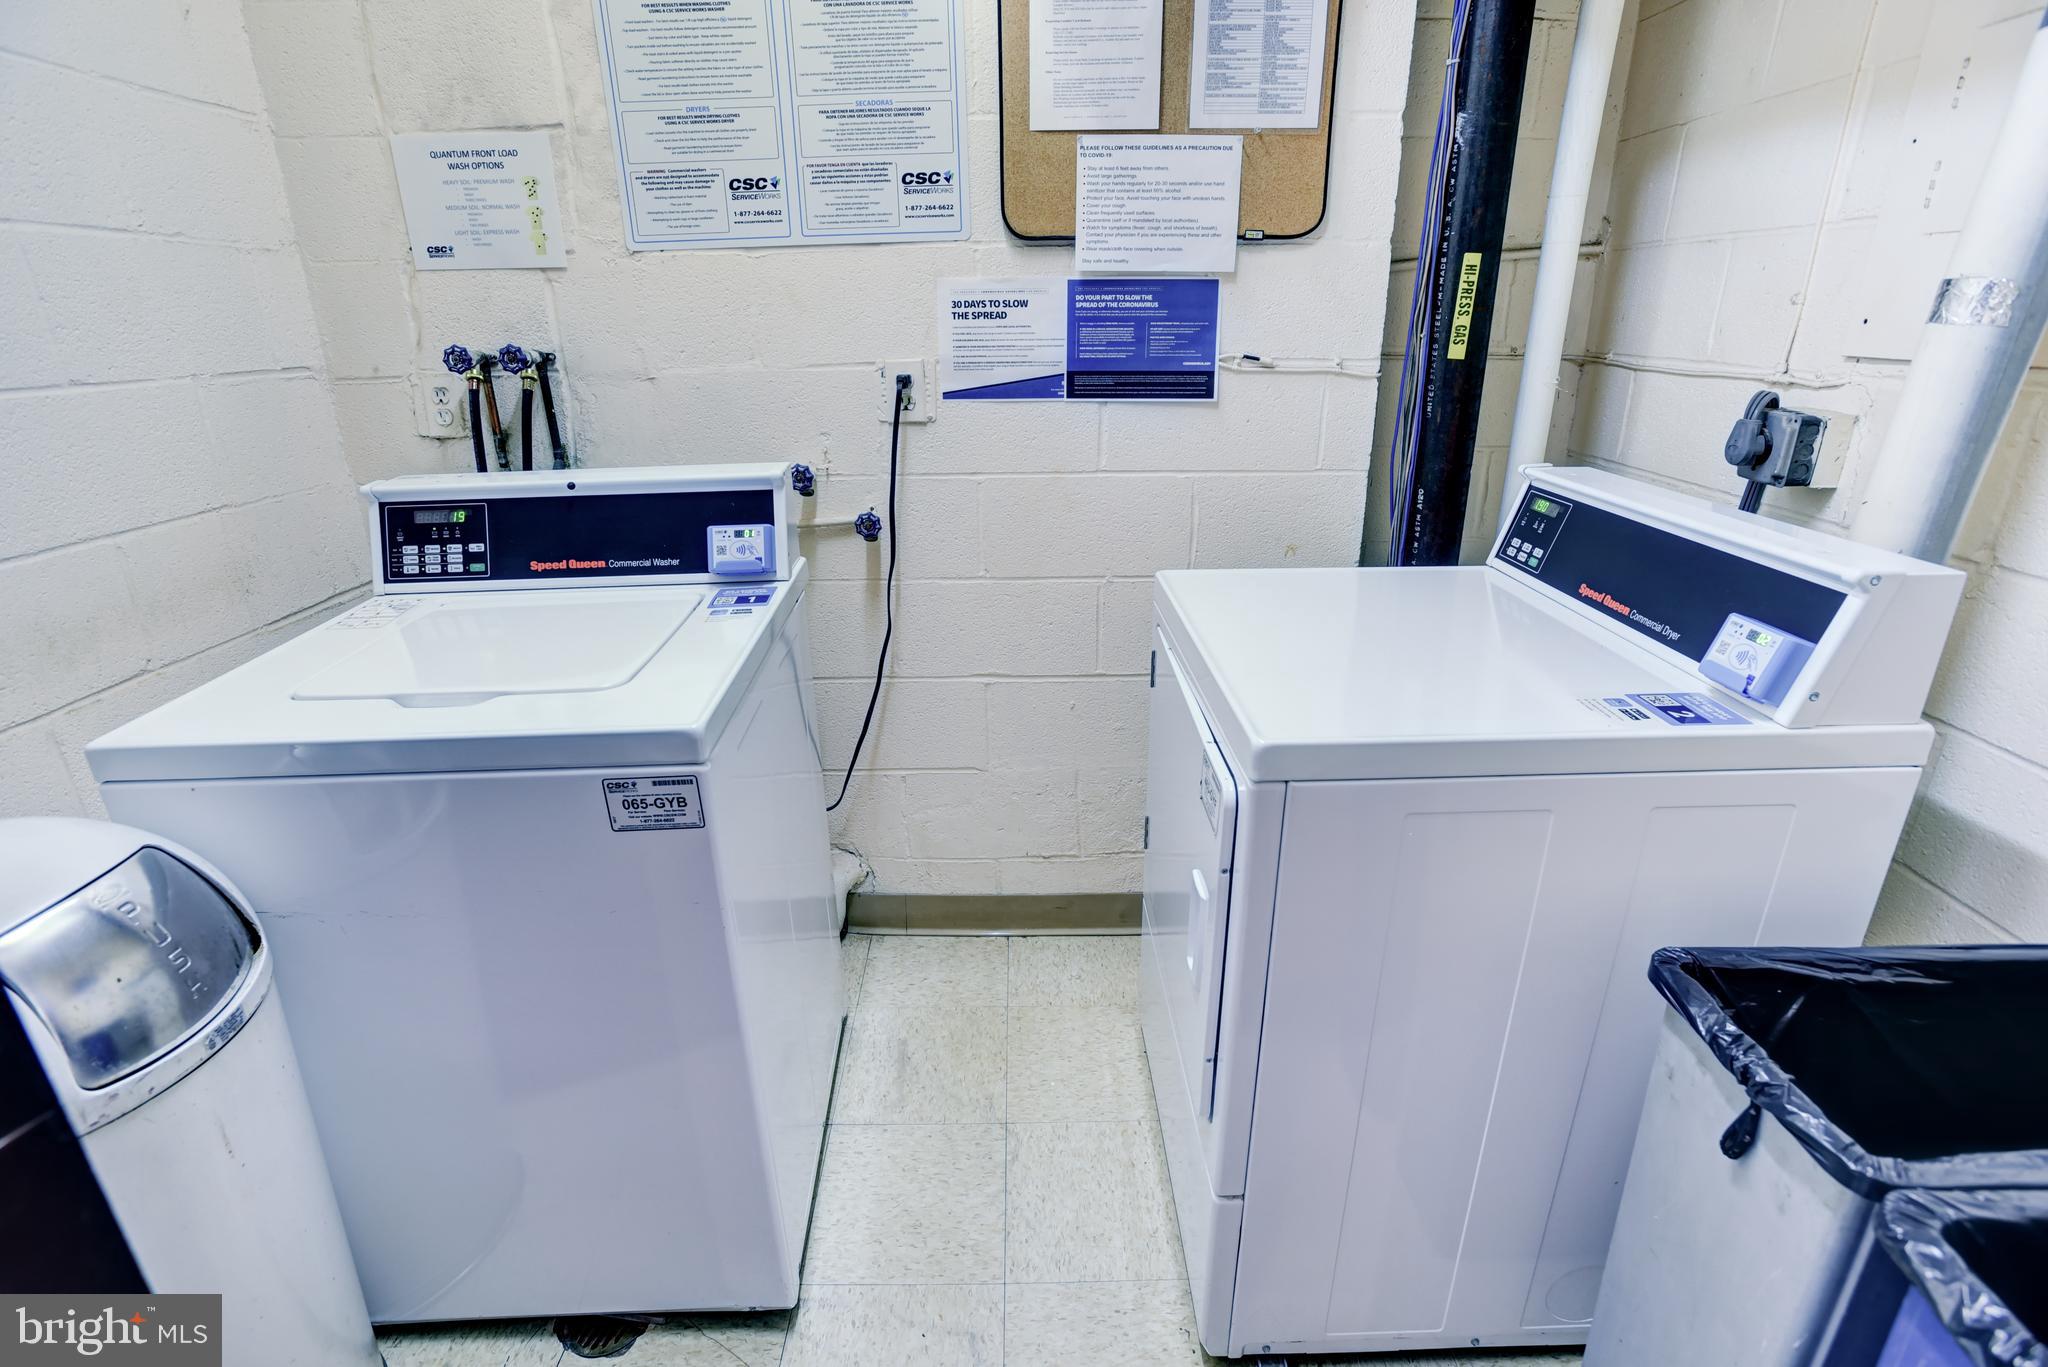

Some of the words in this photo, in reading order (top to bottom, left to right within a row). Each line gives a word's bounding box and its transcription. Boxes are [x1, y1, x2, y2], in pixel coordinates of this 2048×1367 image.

[430, 150, 468, 160] QUANTUM
[728, 178, 768, 190] CSC
[902, 172, 941, 185] CSC
[1443, 242, 1448, 252] IN
[952, 300, 962, 308] 30
[964, 300, 986, 308] DAYS
[1002, 300, 1028, 308] SLOW
[952, 312, 970, 320] THE
[972, 312, 1007, 320] SPREAD
[1453, 323, 1467, 345] GAS
[454, 511, 465, 522] 19
[530, 560, 566, 572] Speed
[569, 559, 605, 569] Queen
[609, 558, 651, 567] Commercial
[652, 558, 680, 566] Washer
[1578, 583, 1605, 602] Speed
[1603, 595, 1630, 616] Queen
[1629, 609, 1664, 632] Commercial
[1663, 626, 1681, 641] Dryer
[1667, 710, 1695, 720] 2
[622, 797, 688, 810] 065-GYB
